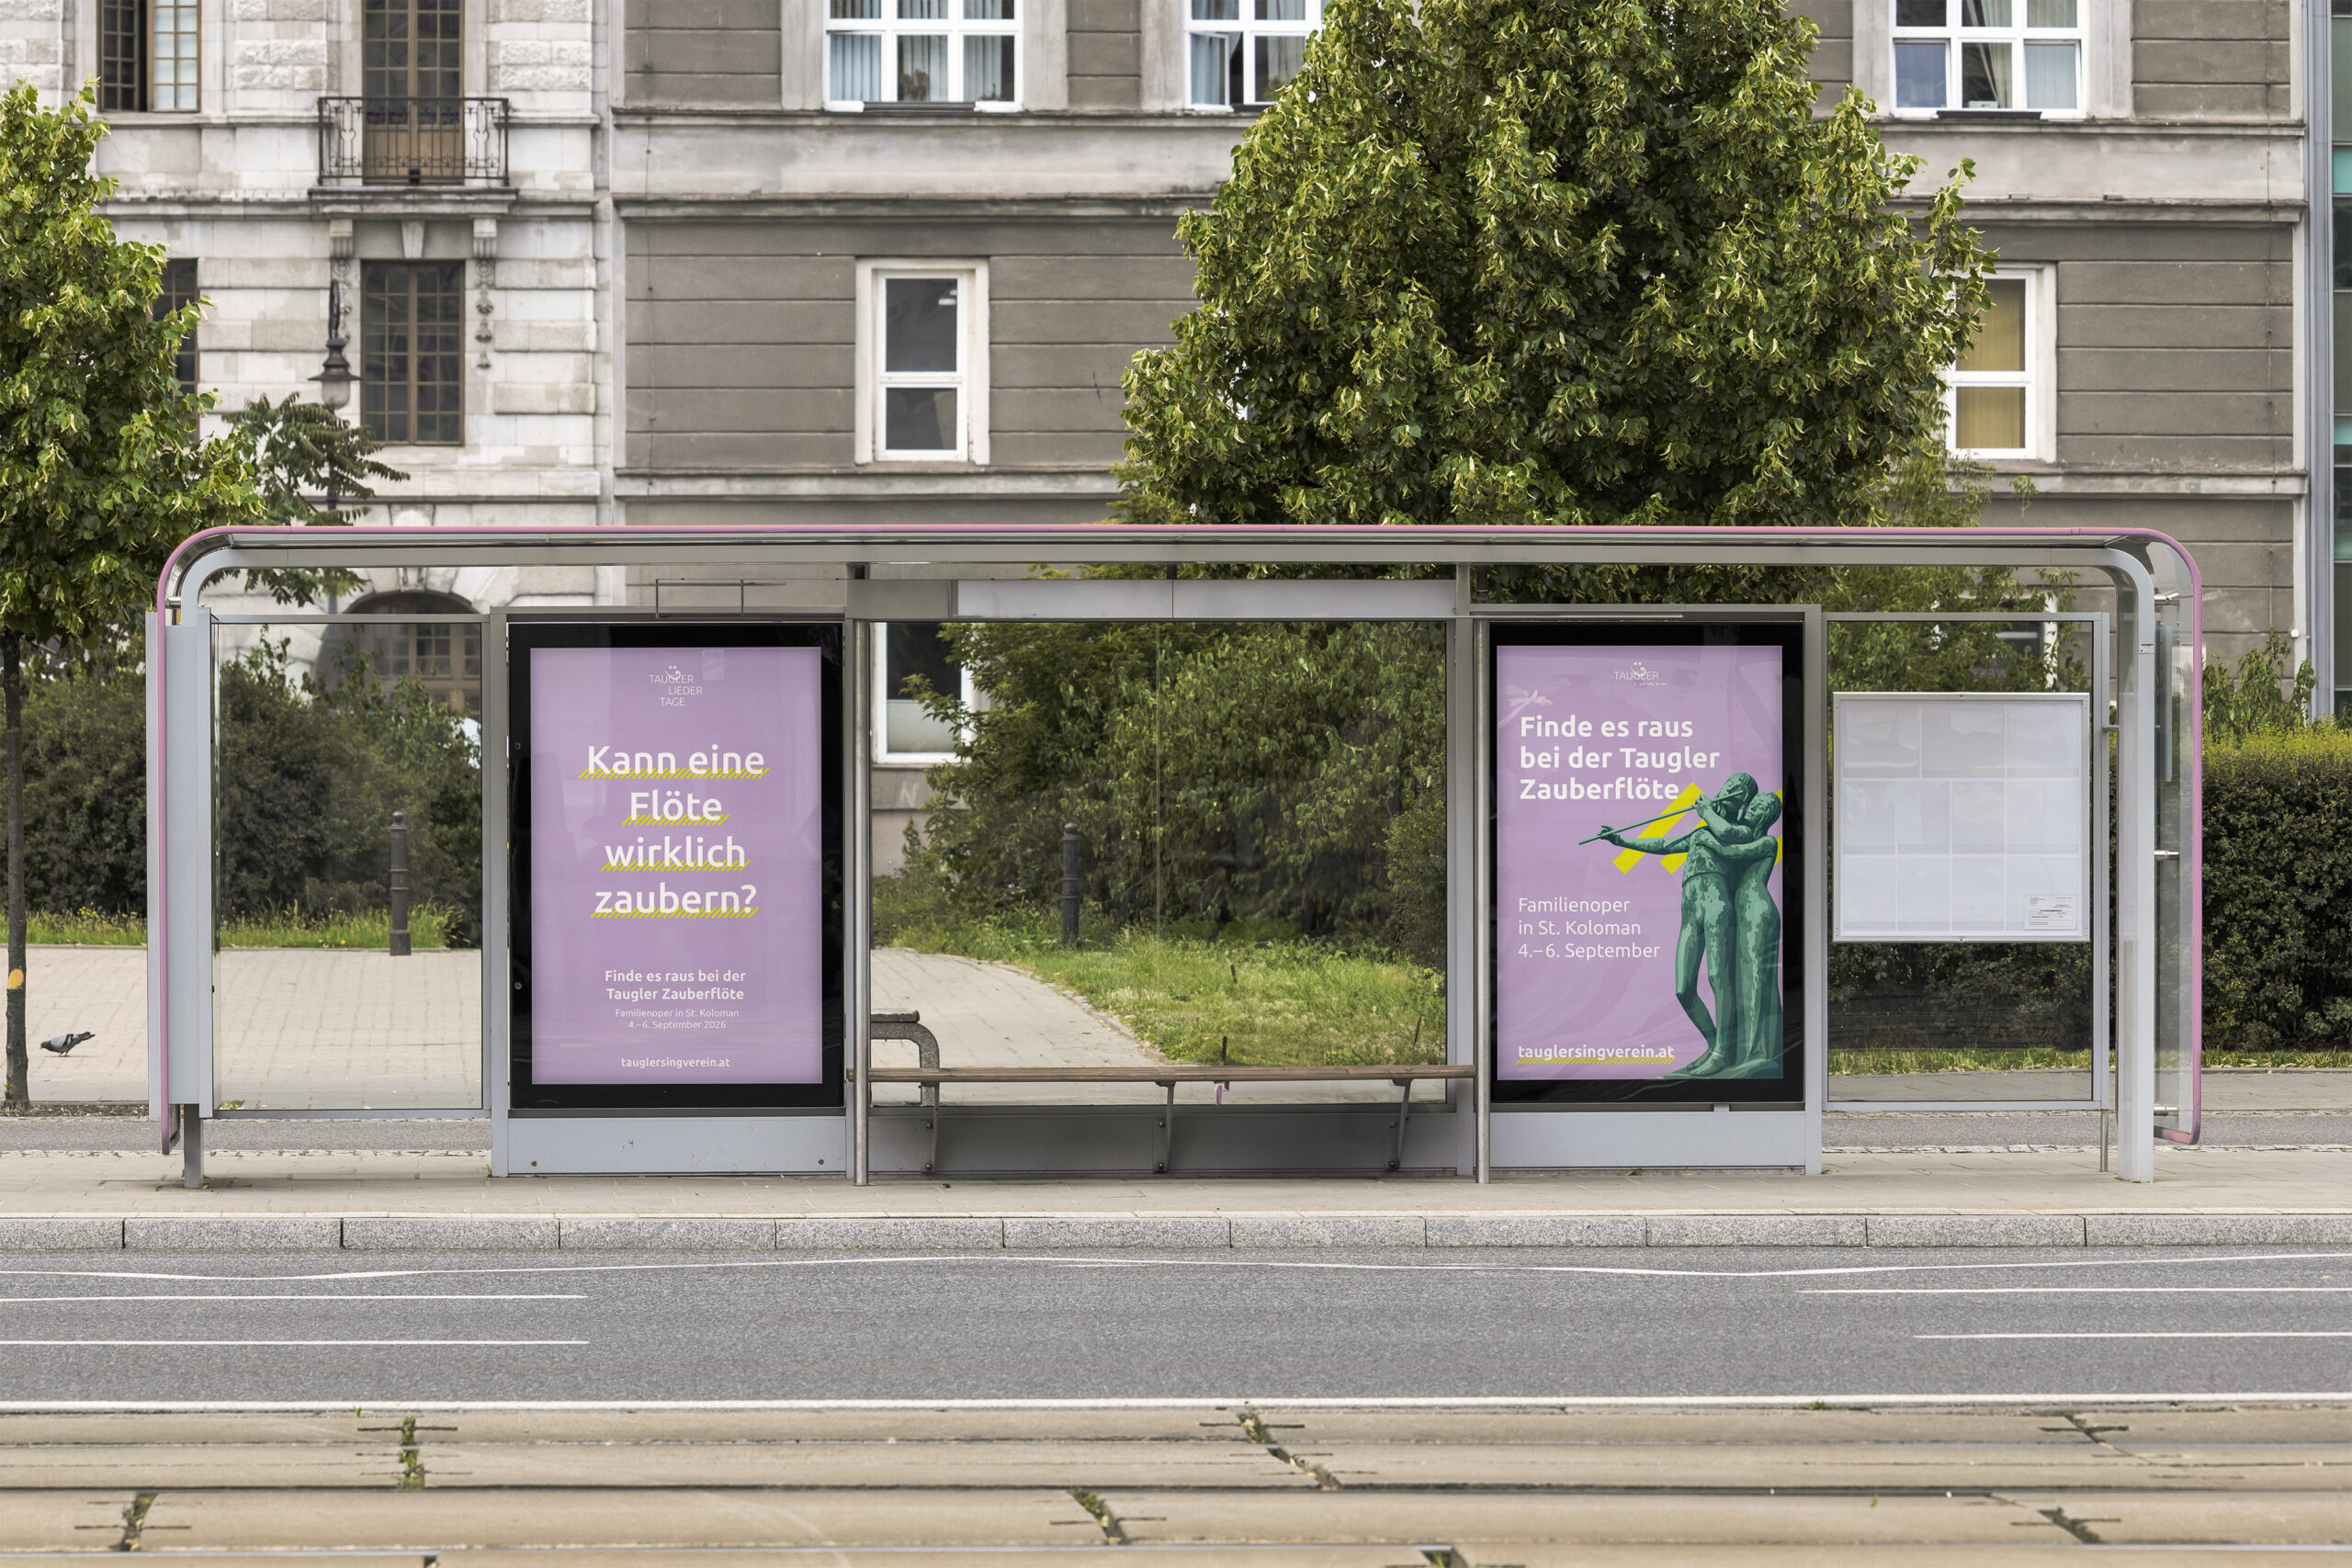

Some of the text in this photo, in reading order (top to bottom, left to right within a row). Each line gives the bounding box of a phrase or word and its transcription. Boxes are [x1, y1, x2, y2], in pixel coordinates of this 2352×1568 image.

[650, 675, 695, 684] TAUGLER
[1613, 671, 1660, 682] TAUGLER
[669, 686, 703, 695] LIEDER
[660, 698, 685, 706] TAGE
[1521, 715, 1693, 738] Finde es raus
[589, 744, 764, 775] Kann eine
[1521, 746, 1721, 773] bei der Taugler
[1521, 777, 1679, 800] Zauberflöte
[631, 789, 722, 822] Flöte
[605, 836, 745, 868] wirklich
[595, 882, 757, 914] zaubern?
[1520, 897, 1631, 916] Familienoper
[1520, 919, 1641, 935] in St. Koloman
[1566, 942, 1661, 962] September
[605, 970, 747, 982] Finde es raus bei der
[606, 987, 744, 1002] Taugler Zauberflöte
[616, 1009, 740, 1021] Familienoper in St. Koloman
[652, 1021, 702, 1031] September
[704, 1021, 727, 1030] 2026
[1519, 1044, 1675, 1061] tauglersingverein.at
[622, 1057, 730, 1069] tauglersingverein.at
